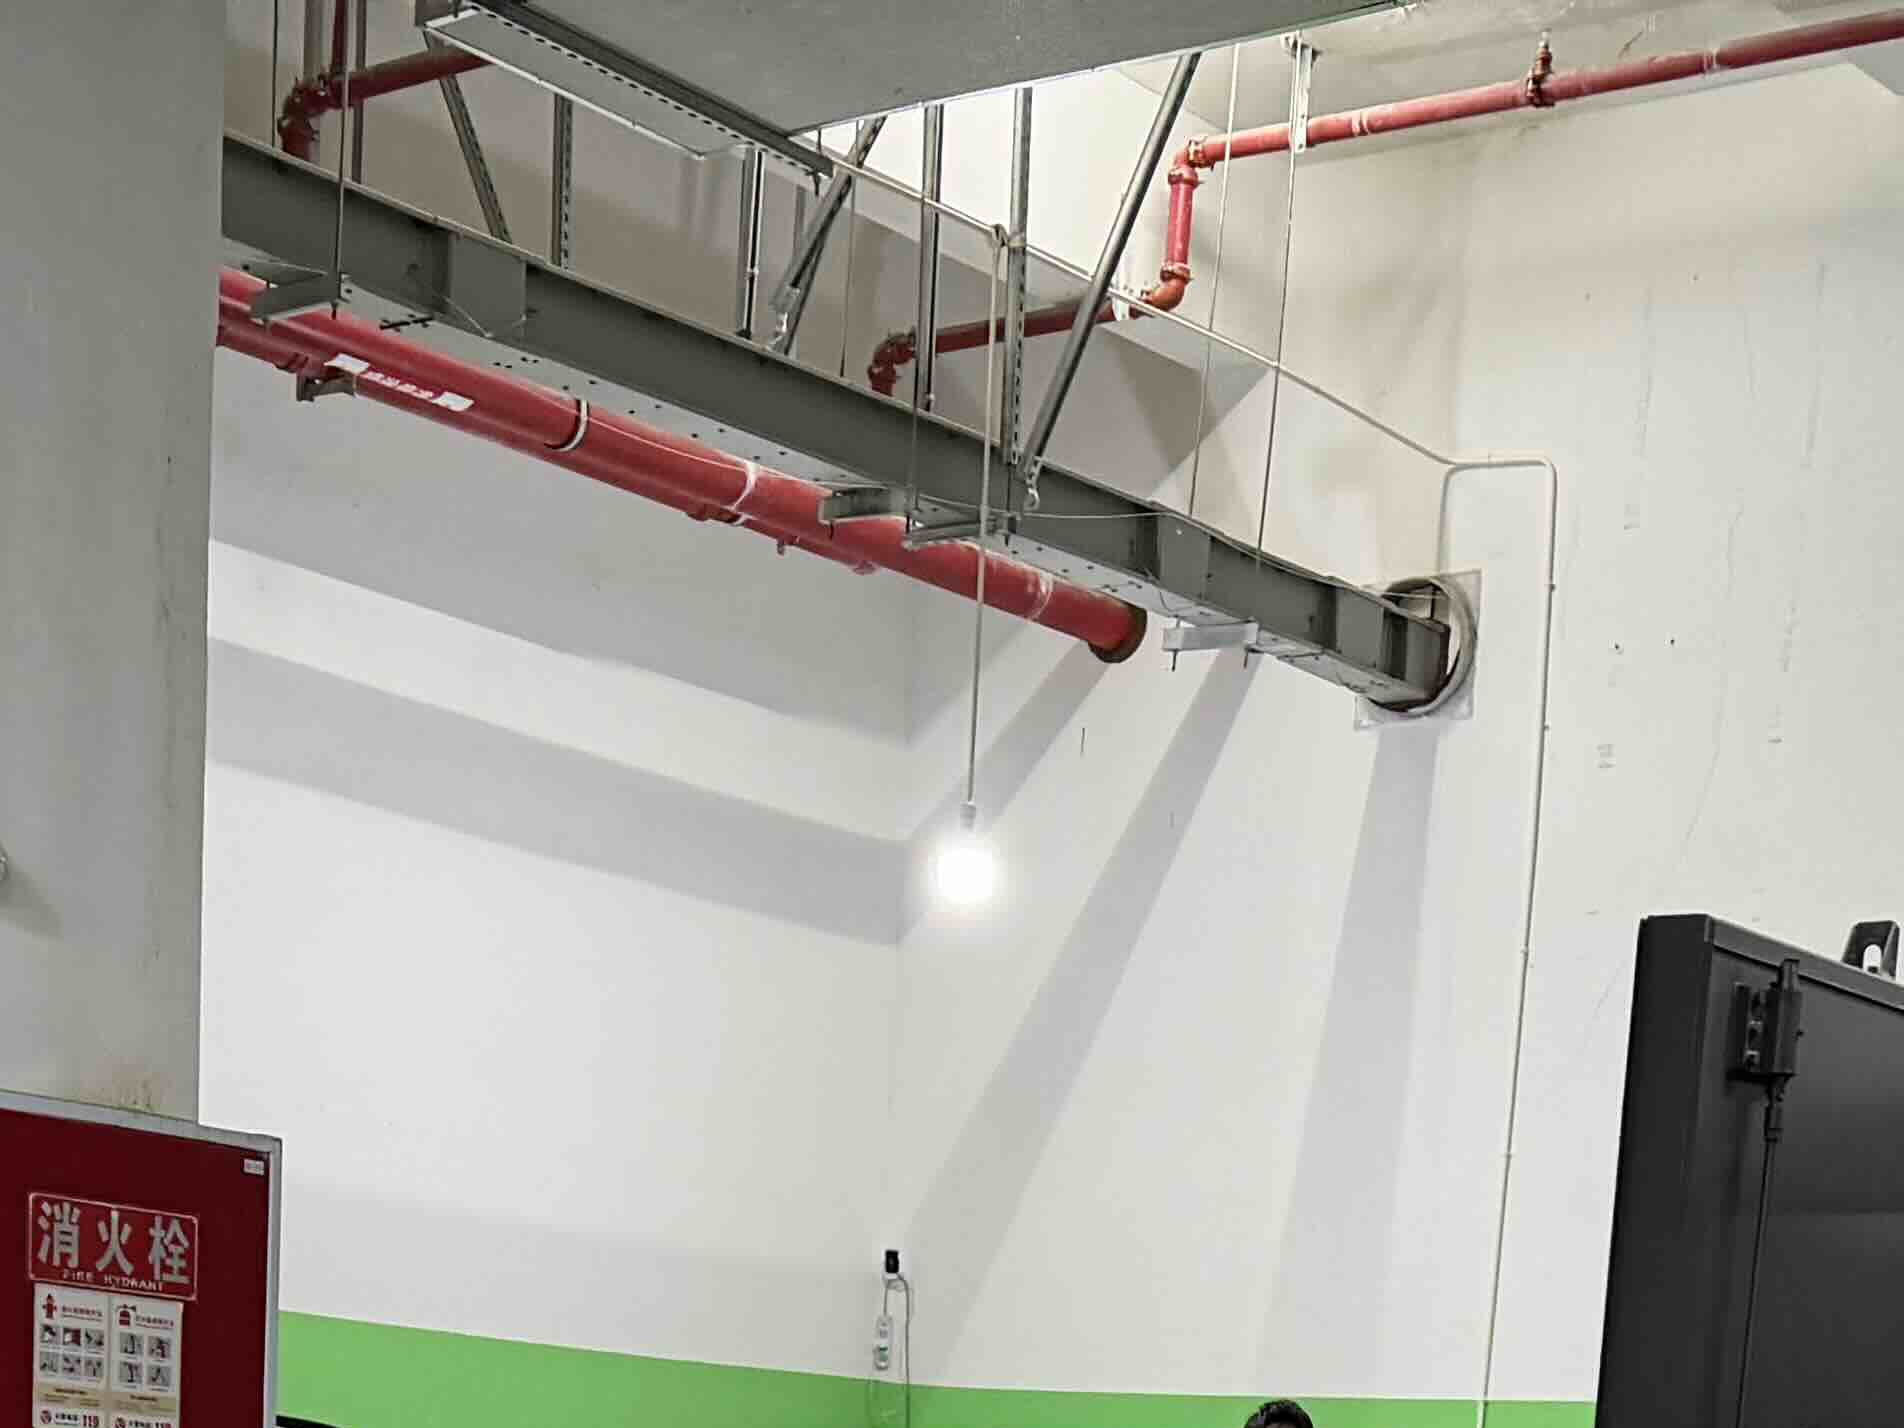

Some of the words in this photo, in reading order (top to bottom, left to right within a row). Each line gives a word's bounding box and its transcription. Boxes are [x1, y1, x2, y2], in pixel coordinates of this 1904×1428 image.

[37, 1200, 191, 1285] 消火栓
[62, 1268, 95, 1282] FIRE
[104, 1274, 164, 1292] HYDRANT
